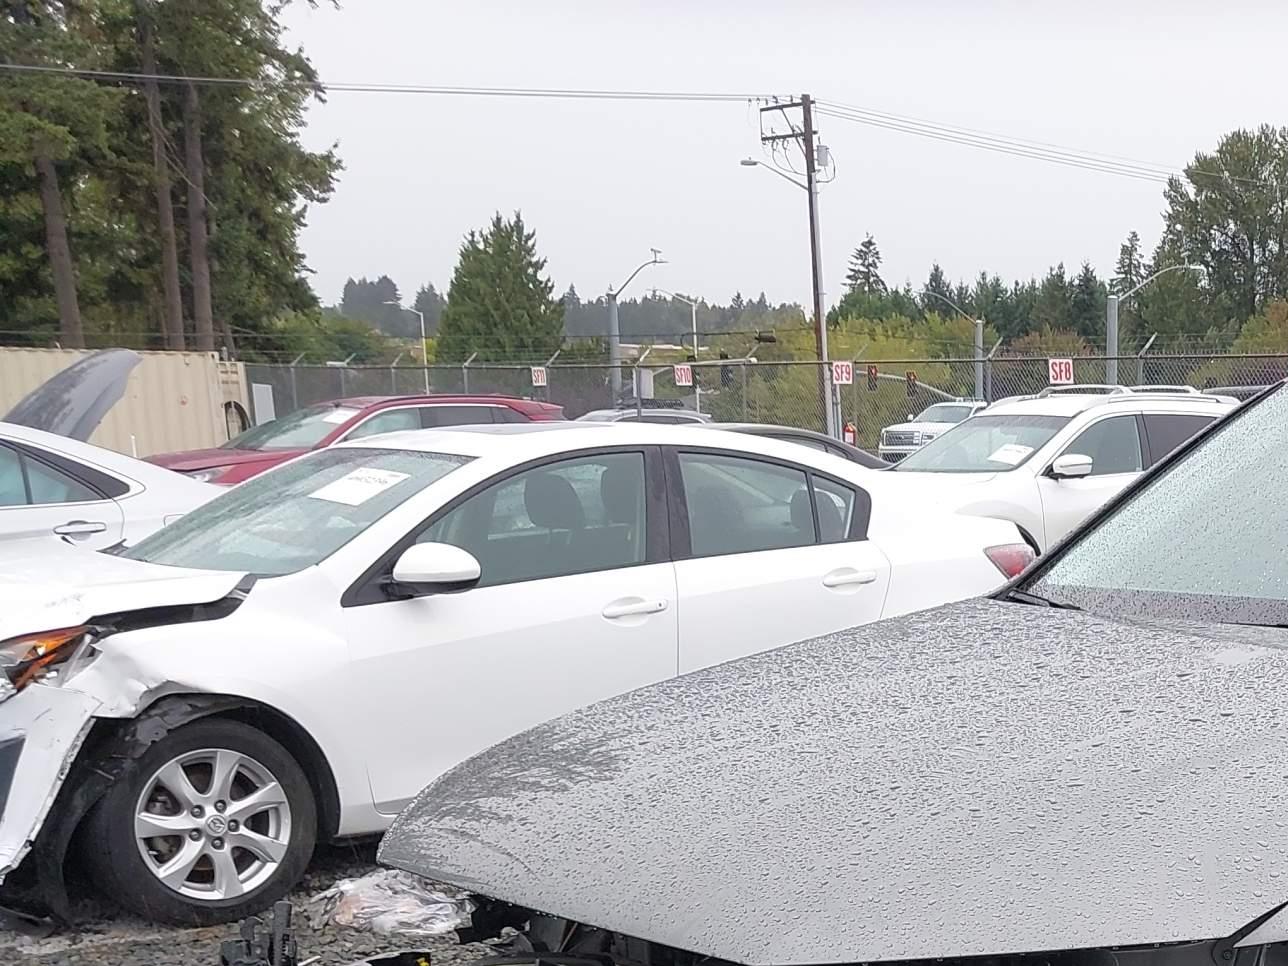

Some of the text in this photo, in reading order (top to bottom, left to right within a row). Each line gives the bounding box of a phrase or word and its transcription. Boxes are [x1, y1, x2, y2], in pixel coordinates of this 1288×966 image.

[676, 367, 691, 384] SF10
[834, 364, 851, 382] SF9
[1051, 361, 1072, 381] SF8
